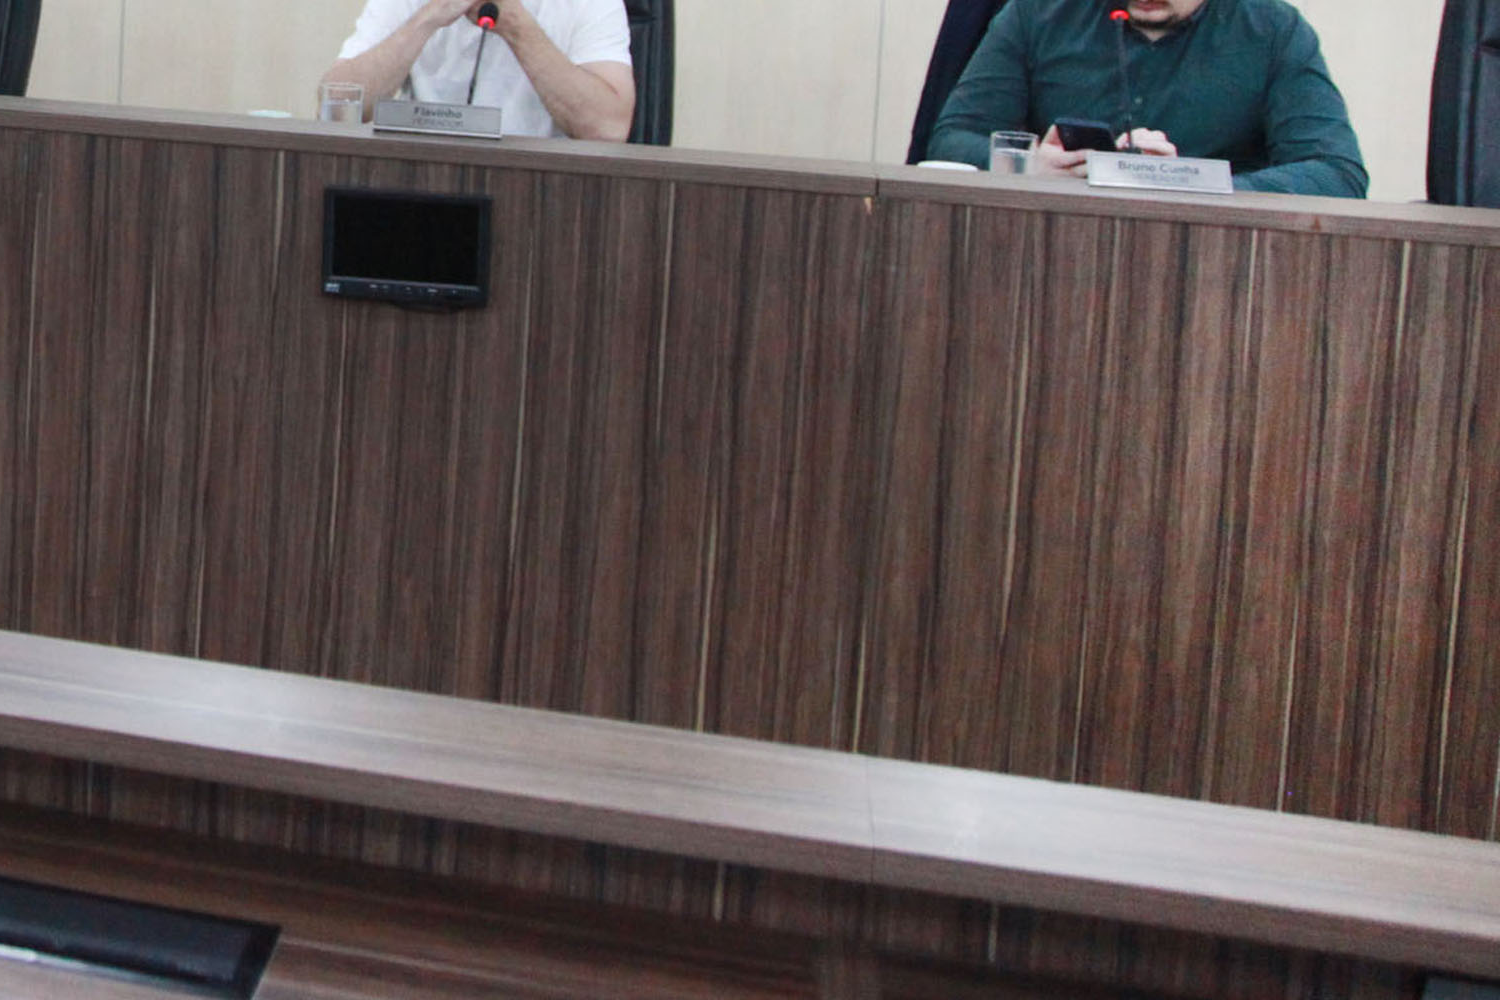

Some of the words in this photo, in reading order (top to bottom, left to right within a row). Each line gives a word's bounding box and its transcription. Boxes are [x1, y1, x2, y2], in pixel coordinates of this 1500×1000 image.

[414, 106, 463, 118] Flavinho
[1118, 160, 1156, 173] Bruno
[1159, 163, 1200, 175] Cunha
